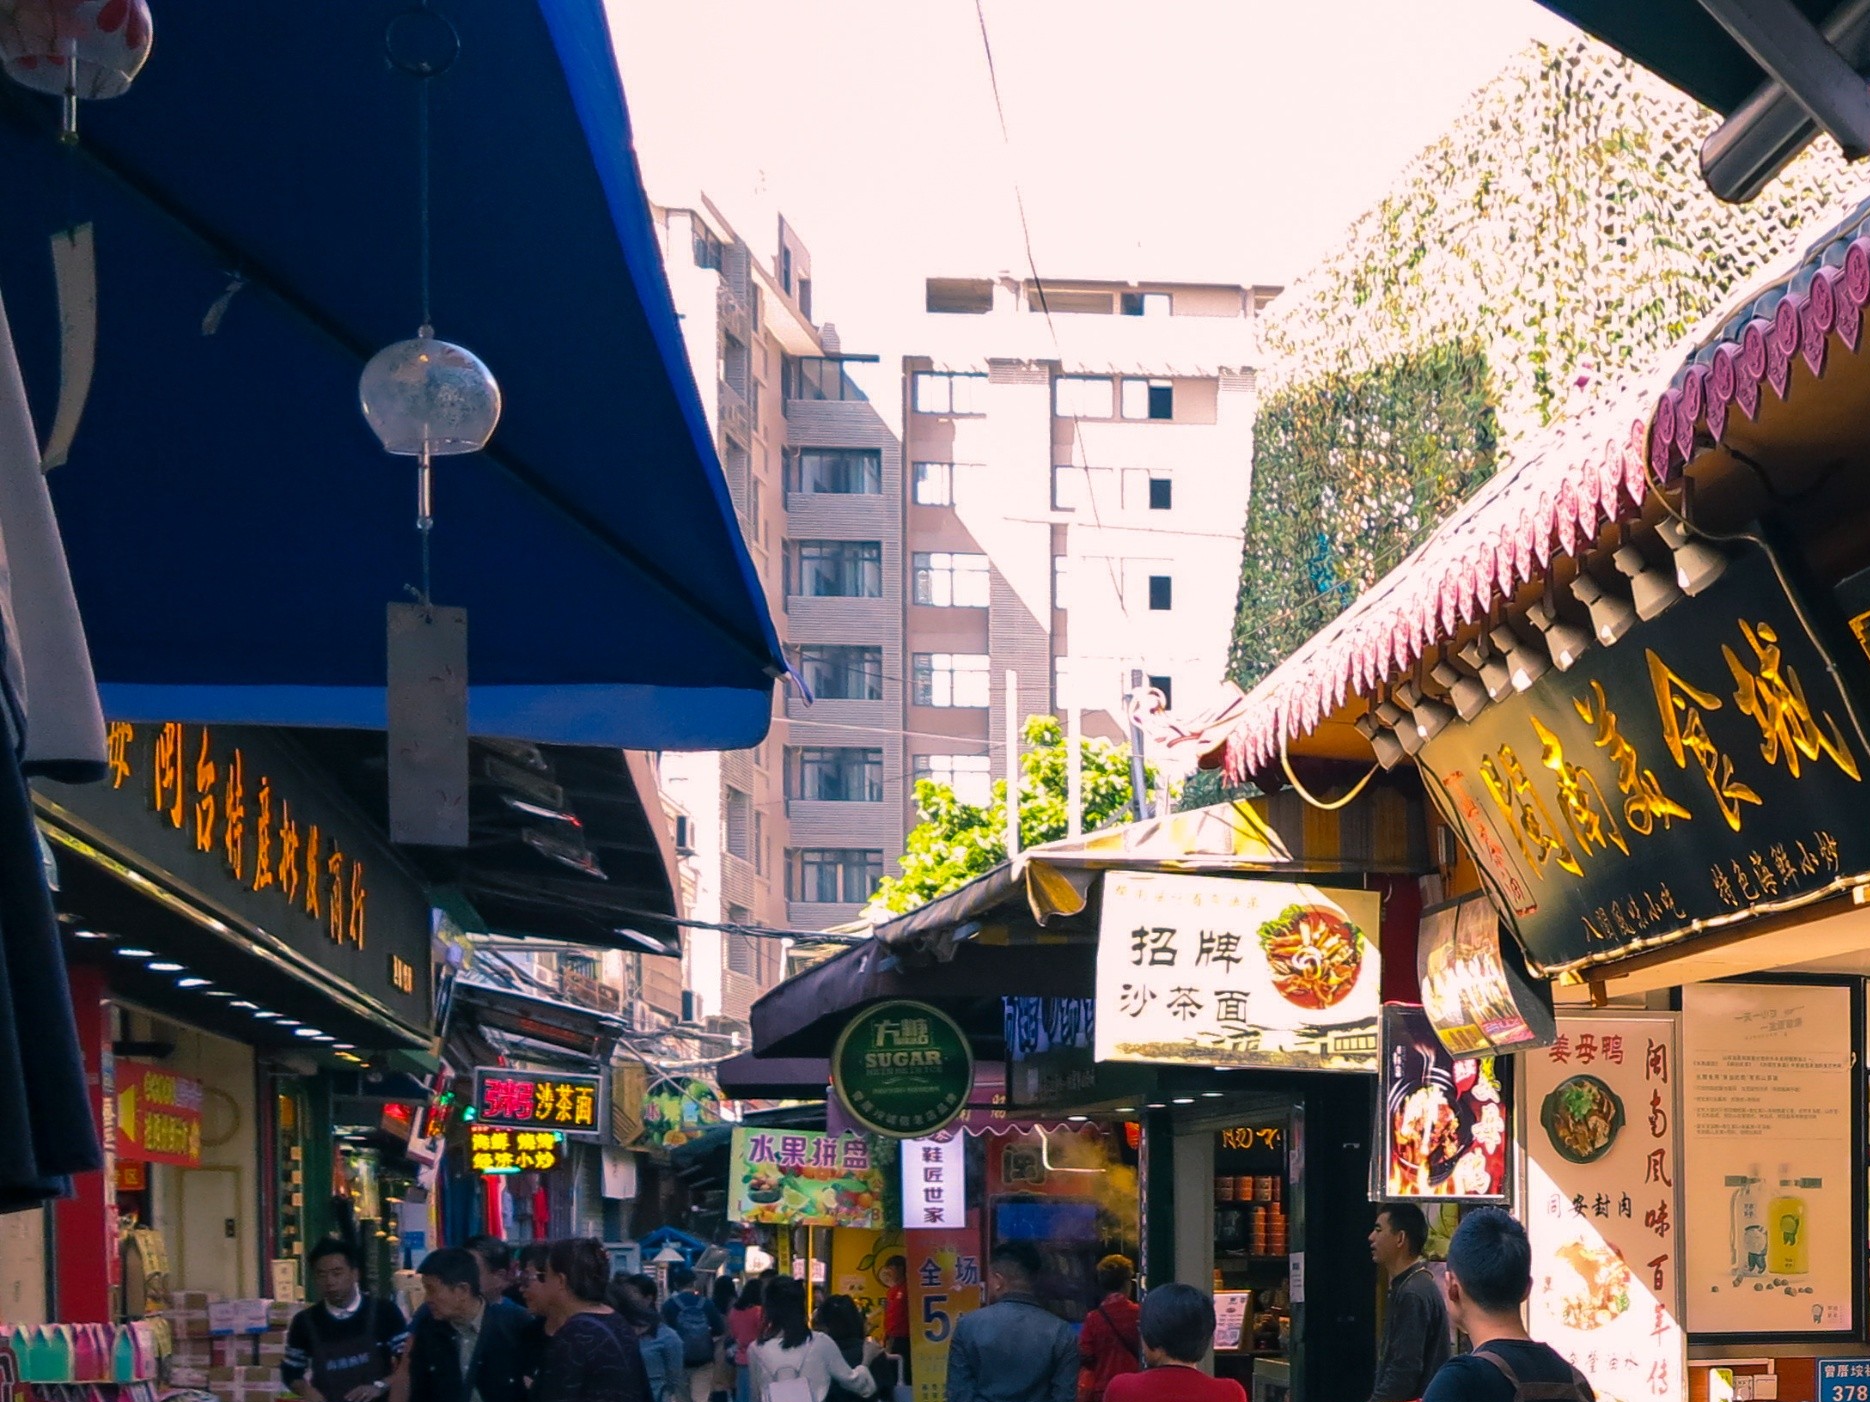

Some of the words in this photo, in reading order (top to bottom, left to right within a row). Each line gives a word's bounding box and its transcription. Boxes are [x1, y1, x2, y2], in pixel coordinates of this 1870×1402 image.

[1131, 926, 1243, 974] 招牌
[1120, 984, 1251, 1024] 沙茶面
[865, 1050, 942, 1068] SUGAR
[1548, 1033, 1624, 1066] 姜母鸭
[482, 1078, 536, 1120] 粥
[535, 1081, 595, 1126] 沙茶面
[749, 1134, 870, 1171] 水果拼盘
[921, 1146, 946, 1224] 鞋匠世家
[918, 1255, 981, 1290] 全场
[1832, 1386, 1868, 1402] 378
